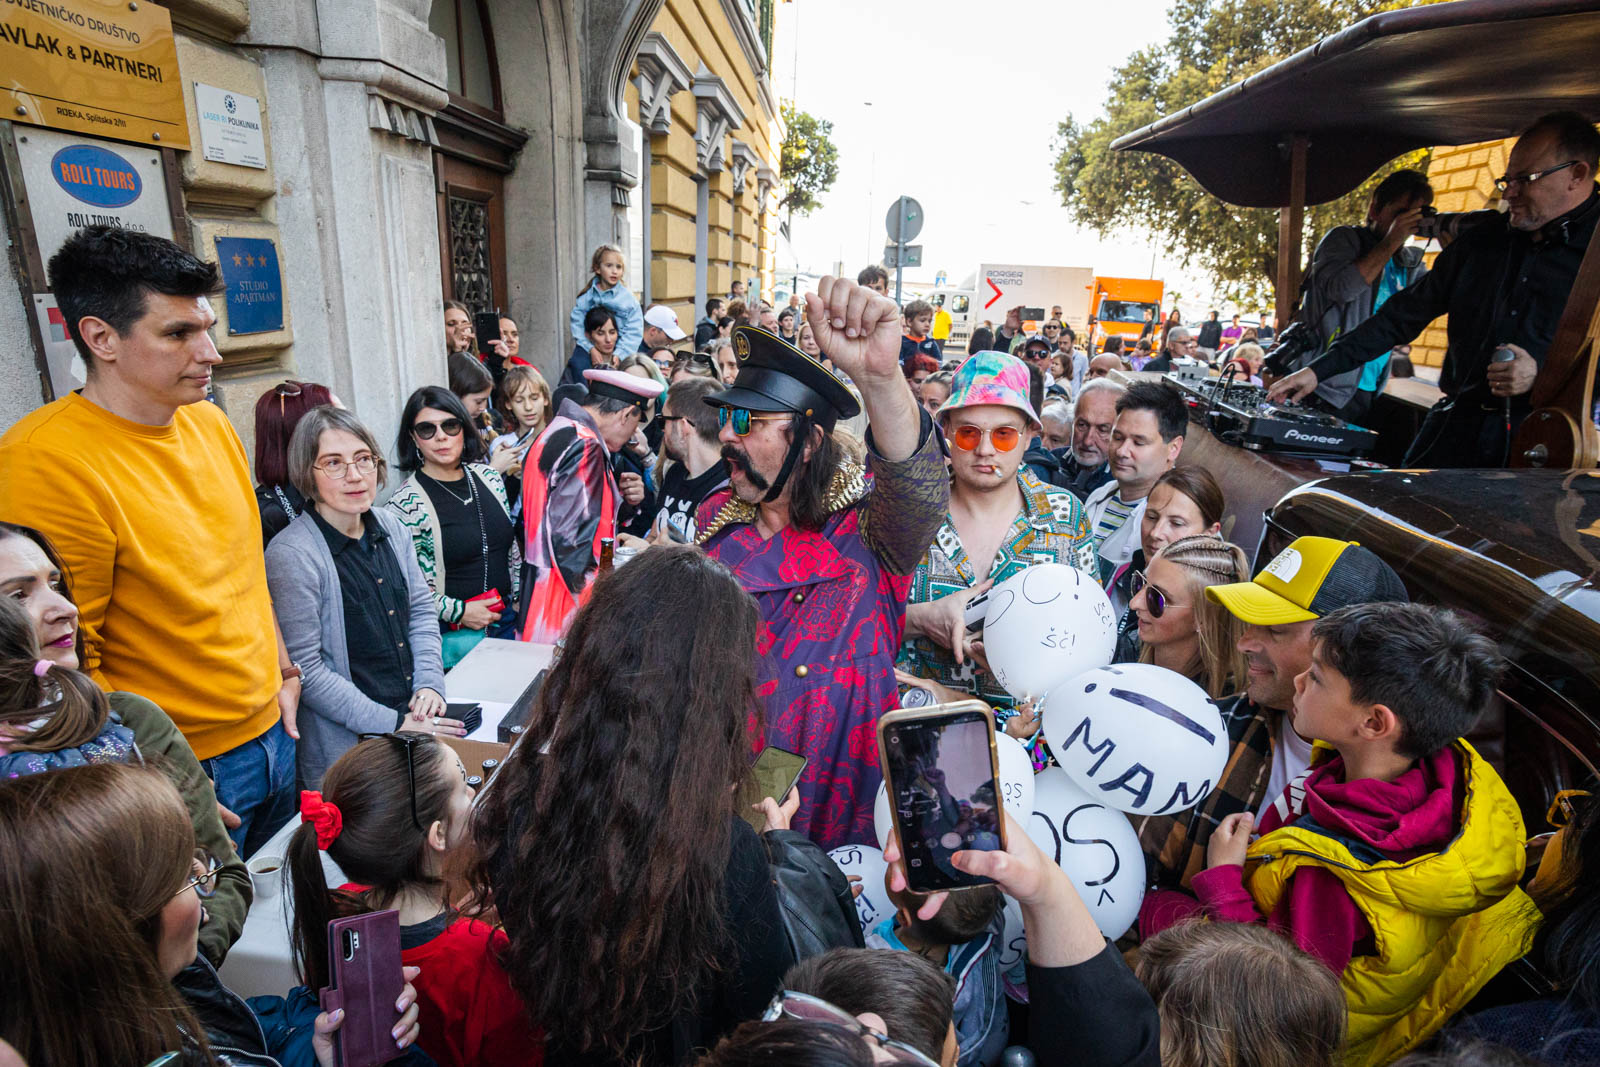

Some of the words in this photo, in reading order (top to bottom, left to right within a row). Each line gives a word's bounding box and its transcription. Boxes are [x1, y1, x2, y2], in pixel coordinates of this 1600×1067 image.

[87, 17, 141, 44] DRUŠTVO
[66, 45, 77, 61] &
[79, 45, 163, 83] PARTNERI
[227, 116, 260, 130] POLIKLINIKA
[60, 162, 93, 185] ROLI
[94, 167, 136, 191] TOURS
[67, 212, 90, 228] ROLI
[91, 214, 122, 229] TOURS
[239, 280, 269, 292] STUDIO
[233, 292, 276, 304] APARTMAN
[1284, 429, 1344, 445] Pioneer
